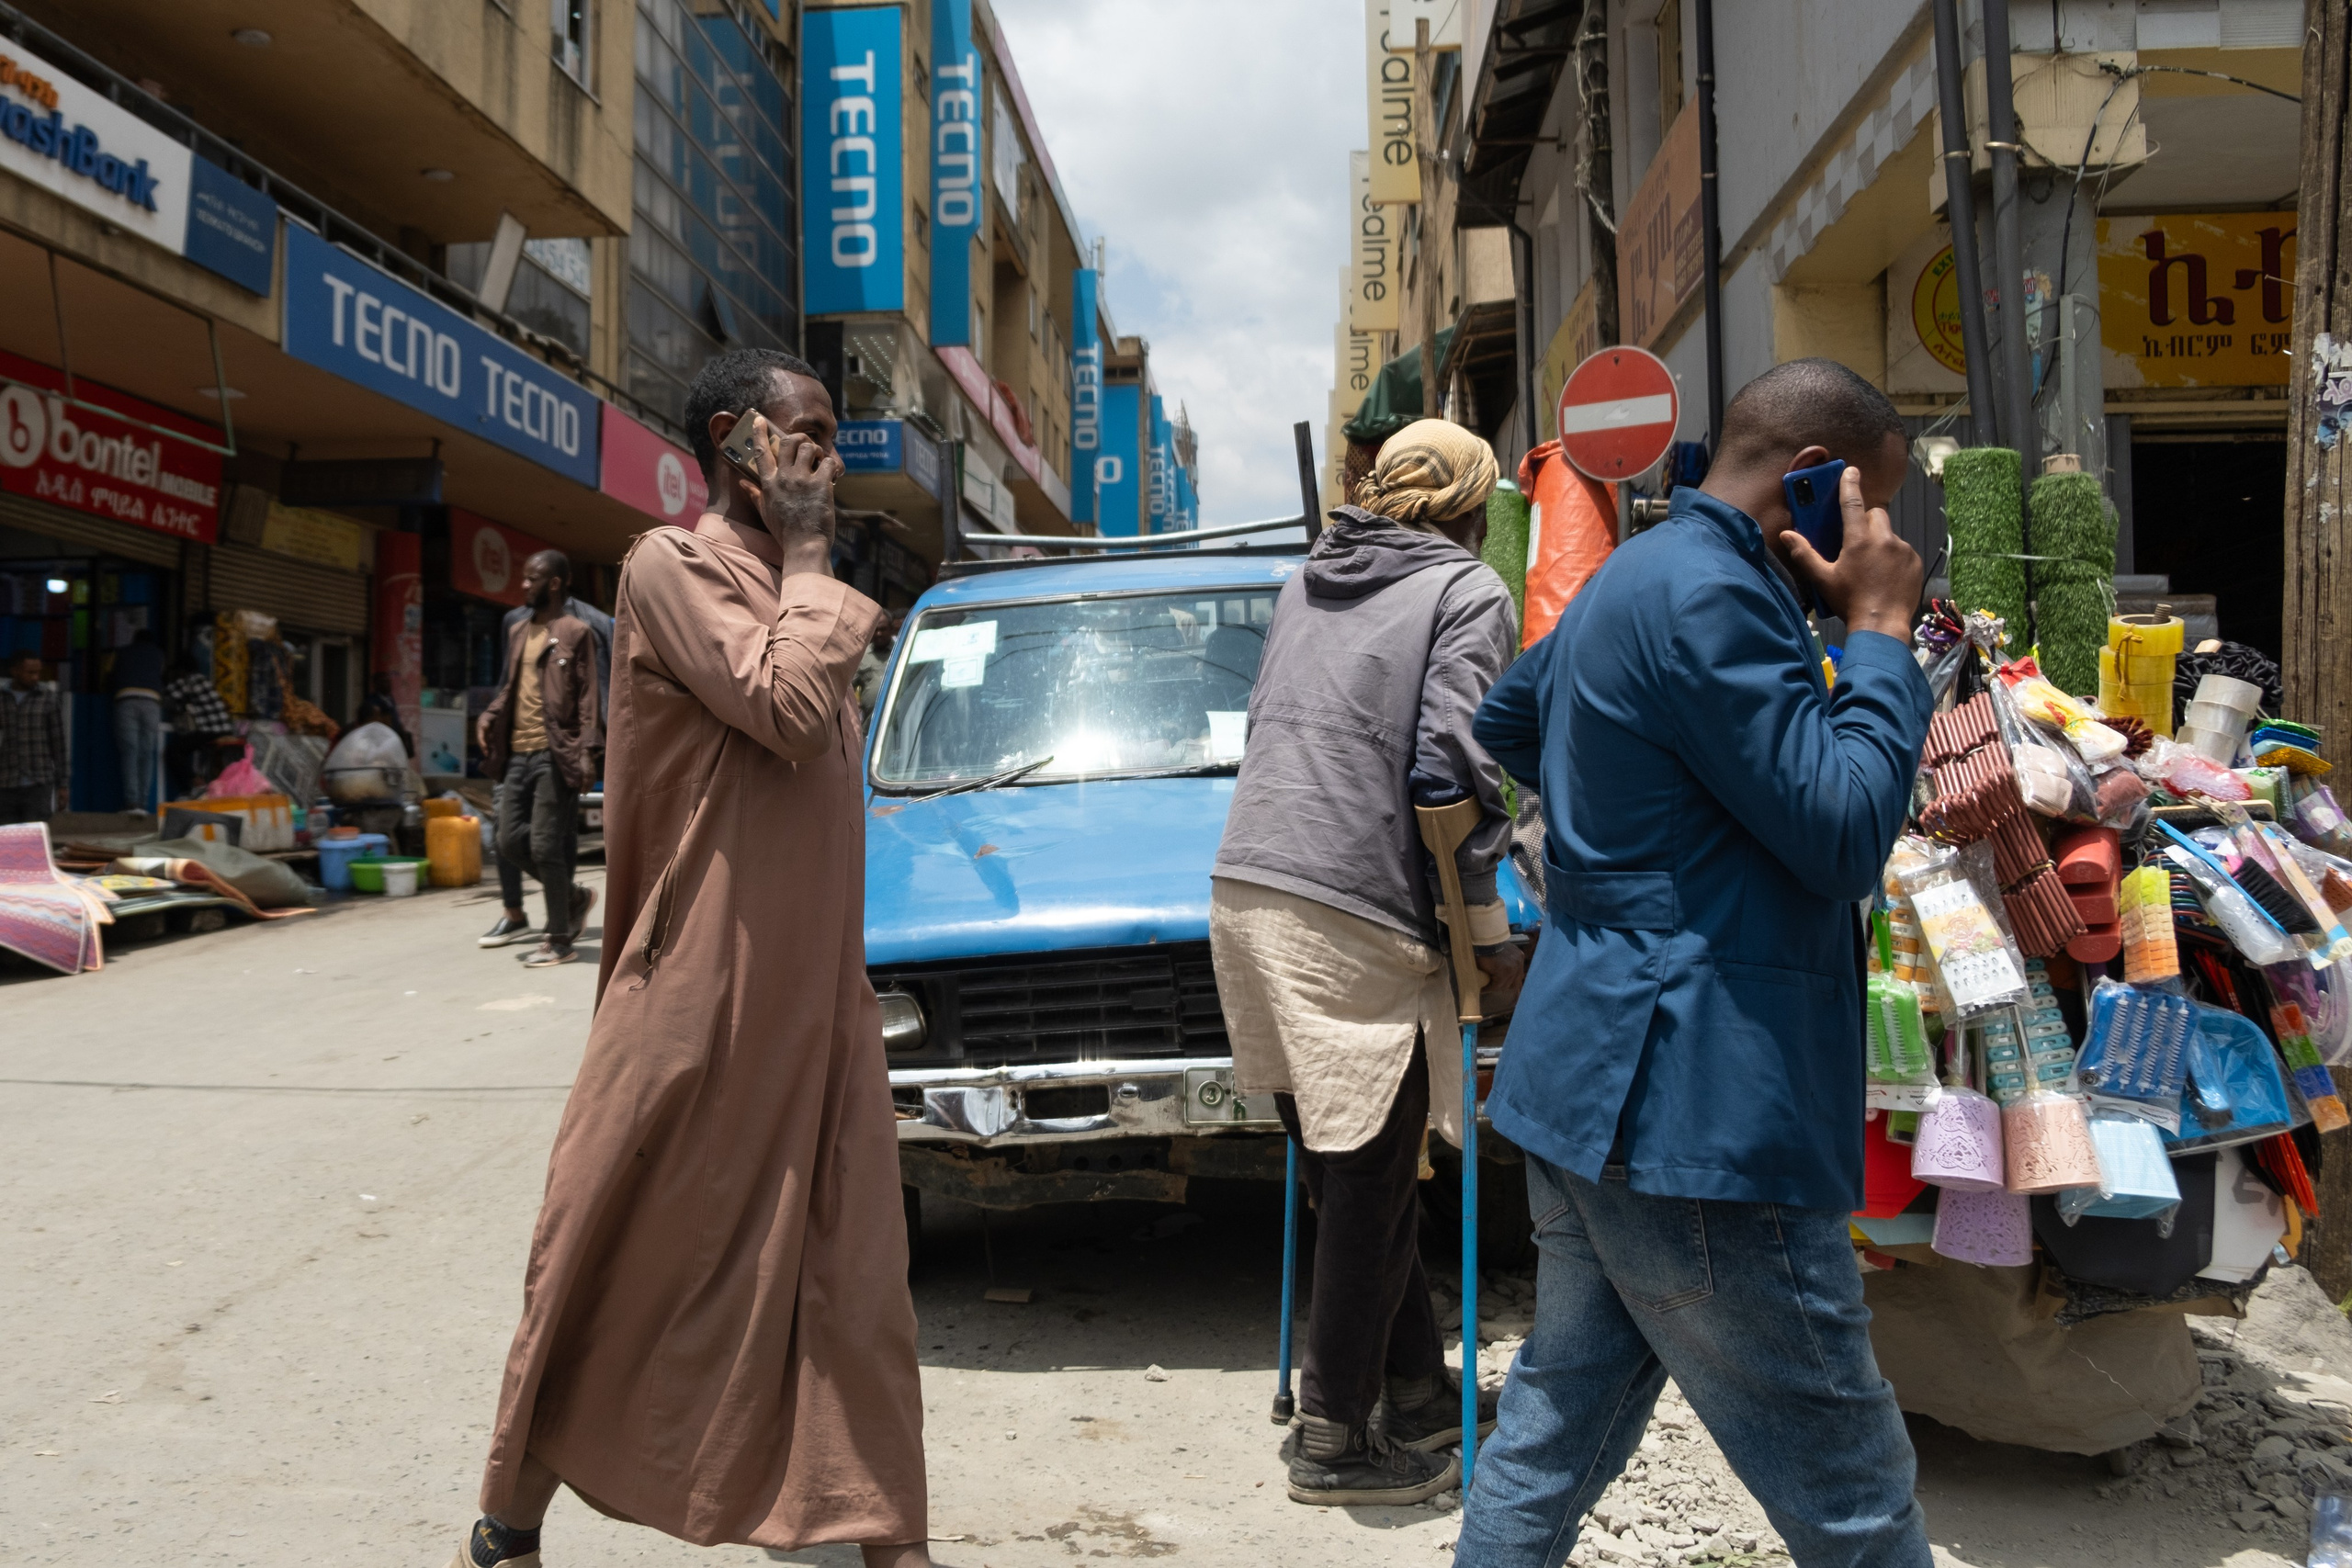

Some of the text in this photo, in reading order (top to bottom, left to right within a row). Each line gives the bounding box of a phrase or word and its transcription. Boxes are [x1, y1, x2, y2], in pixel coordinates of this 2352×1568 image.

[937, 52, 975, 227] TECNO
[1380, 9, 1414, 166] alme
[830, 50, 878, 268] TECNO
[323, 273, 580, 457] TECNO TECNO
[1074, 341, 1099, 450] TECNO
[48, 389, 161, 488] bontel
[160, 471, 218, 507] MOBILE
[835, 429, 888, 446] ECNO
[1150, 443, 1165, 514] TECNO
[1206, 1087, 1216, 1101] 3
